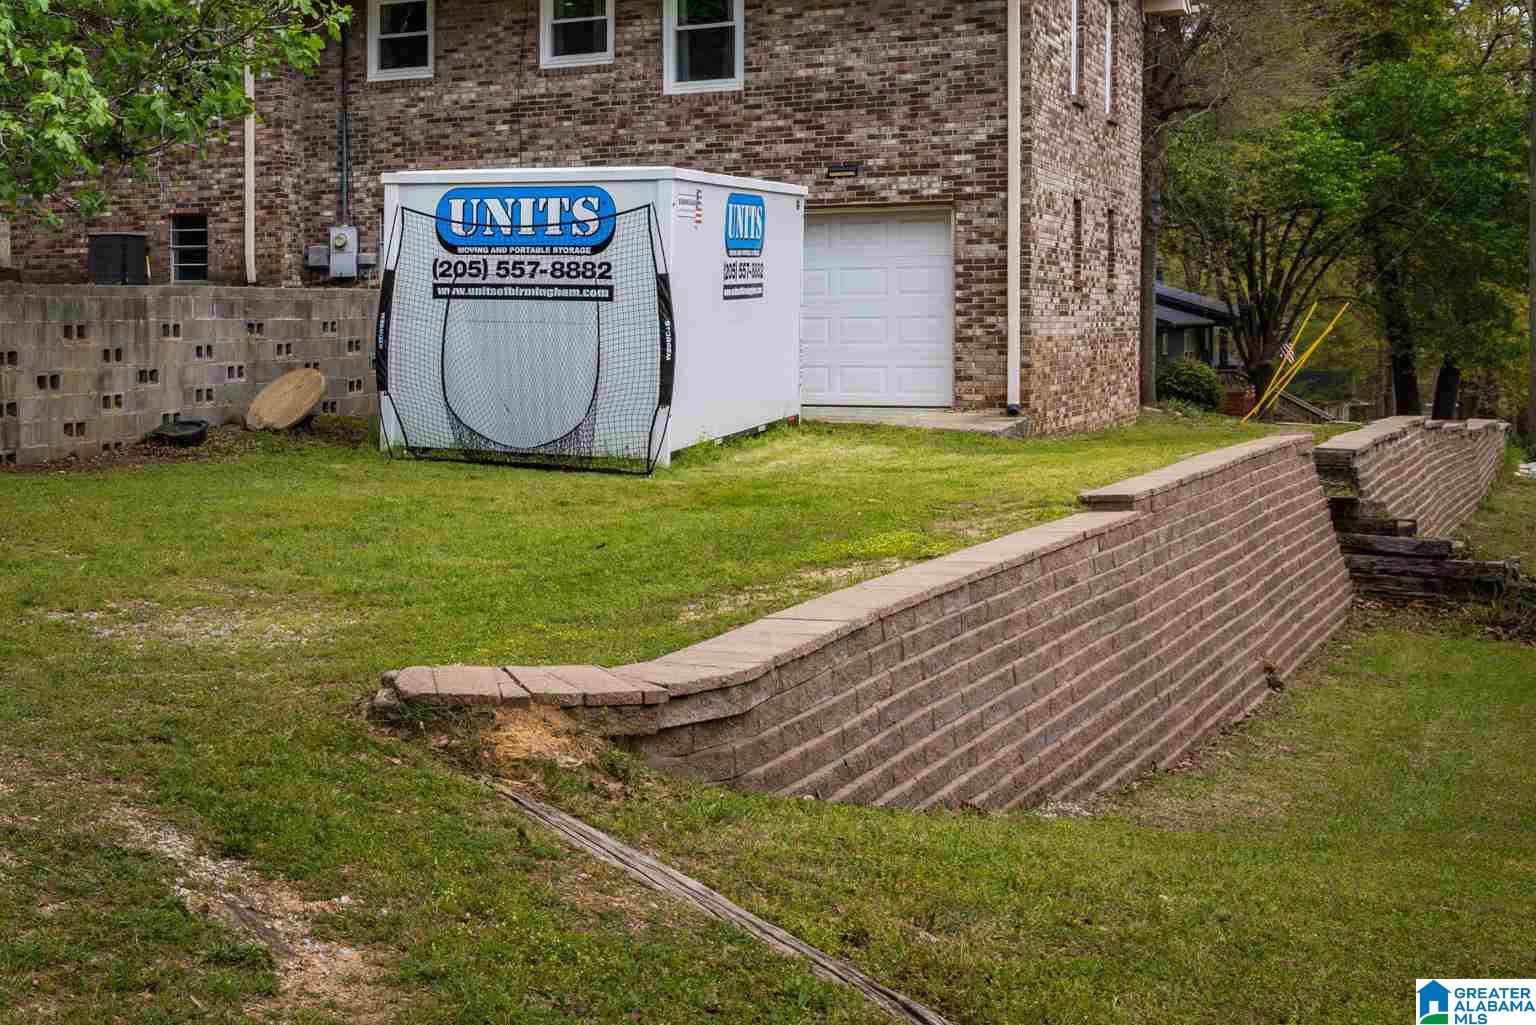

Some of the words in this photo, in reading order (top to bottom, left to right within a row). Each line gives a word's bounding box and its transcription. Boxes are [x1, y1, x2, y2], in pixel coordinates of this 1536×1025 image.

[449, 197, 600, 236] UNITS
[728, 203, 763, 239] UNITS
[433, 259, 488, 280] (205)
[496, 261, 612, 279] 557-8882
